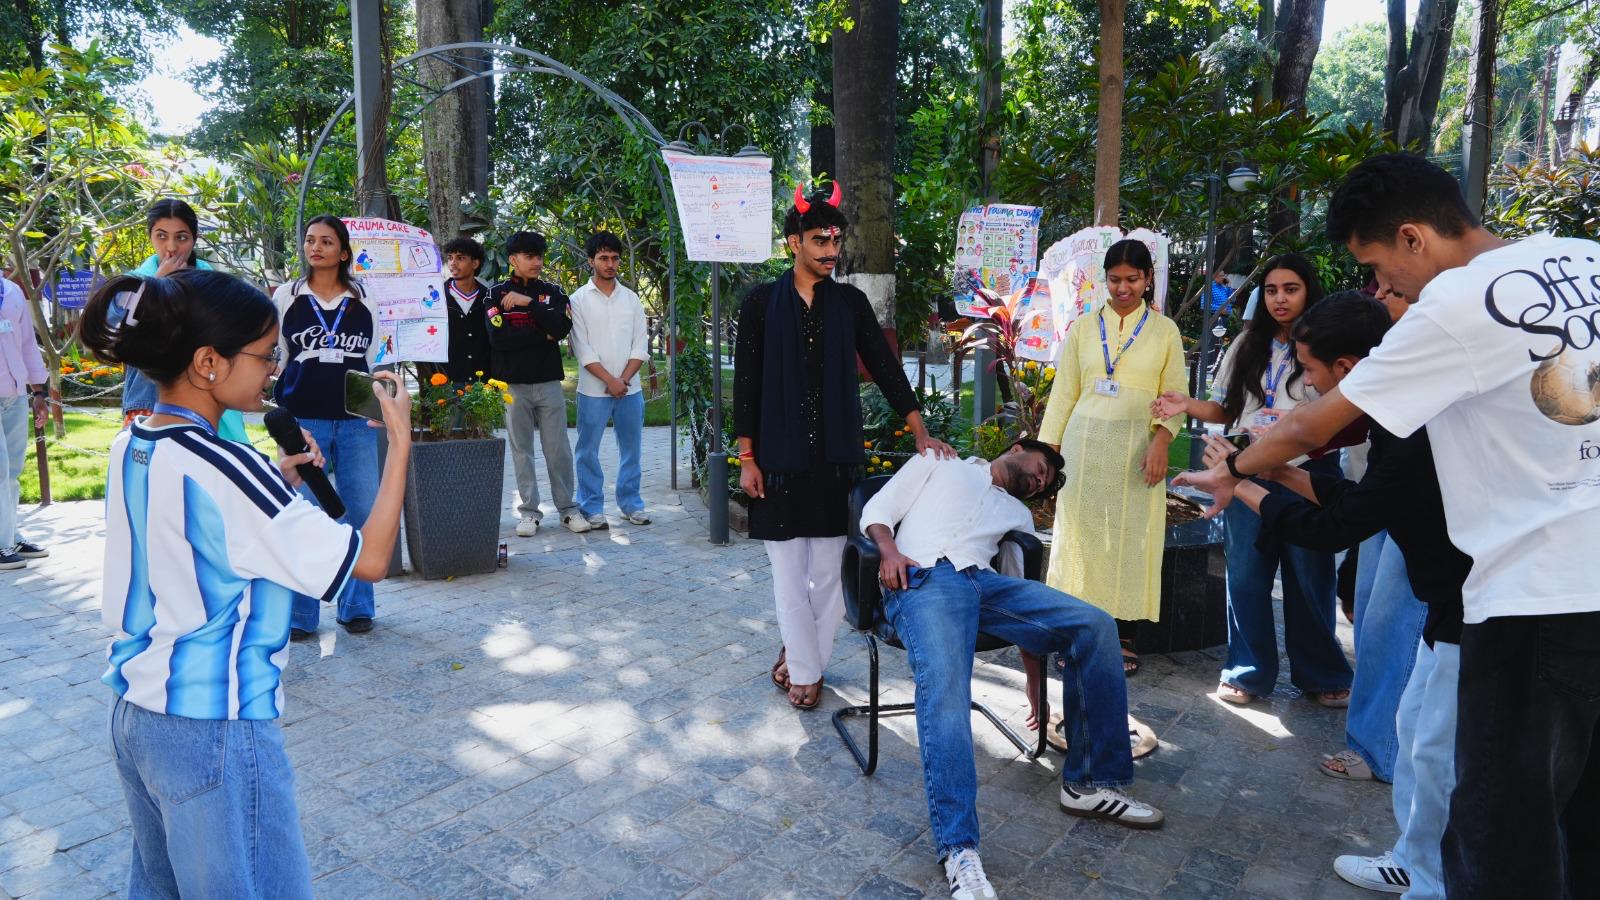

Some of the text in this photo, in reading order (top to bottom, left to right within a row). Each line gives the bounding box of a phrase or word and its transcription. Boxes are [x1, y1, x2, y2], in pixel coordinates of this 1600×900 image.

[1017, 208, 1034, 219] Day
[387, 223, 410, 233] CARE
[291, 325, 369, 352] Georgia
